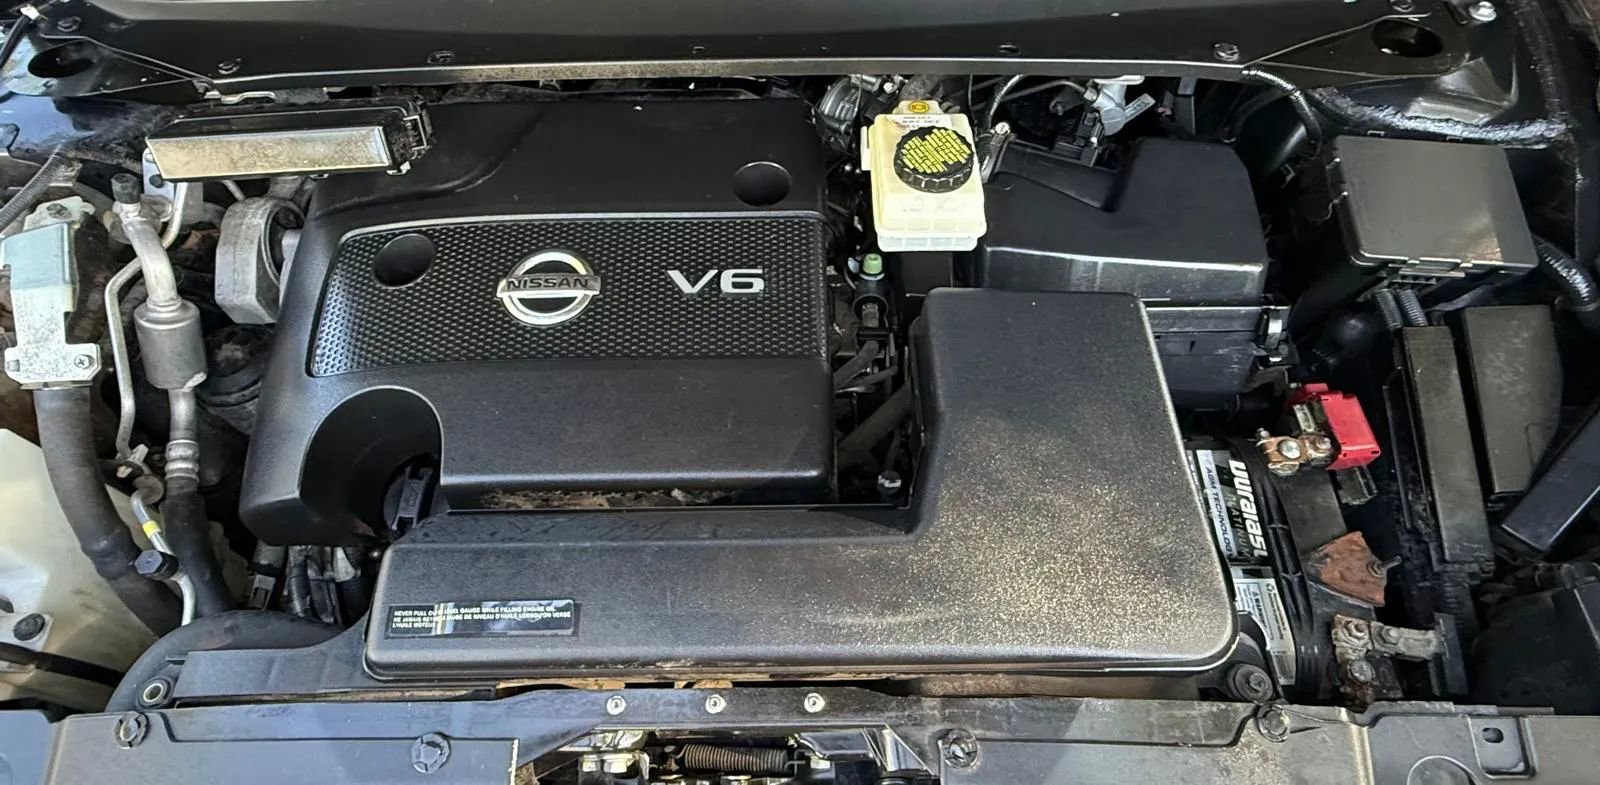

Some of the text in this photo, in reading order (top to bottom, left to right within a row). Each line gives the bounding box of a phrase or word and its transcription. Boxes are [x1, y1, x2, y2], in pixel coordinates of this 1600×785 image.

[507, 277, 589, 290] NISSAN
[667, 269, 765, 294] V6
[1205, 467, 1217, 489] AGM
